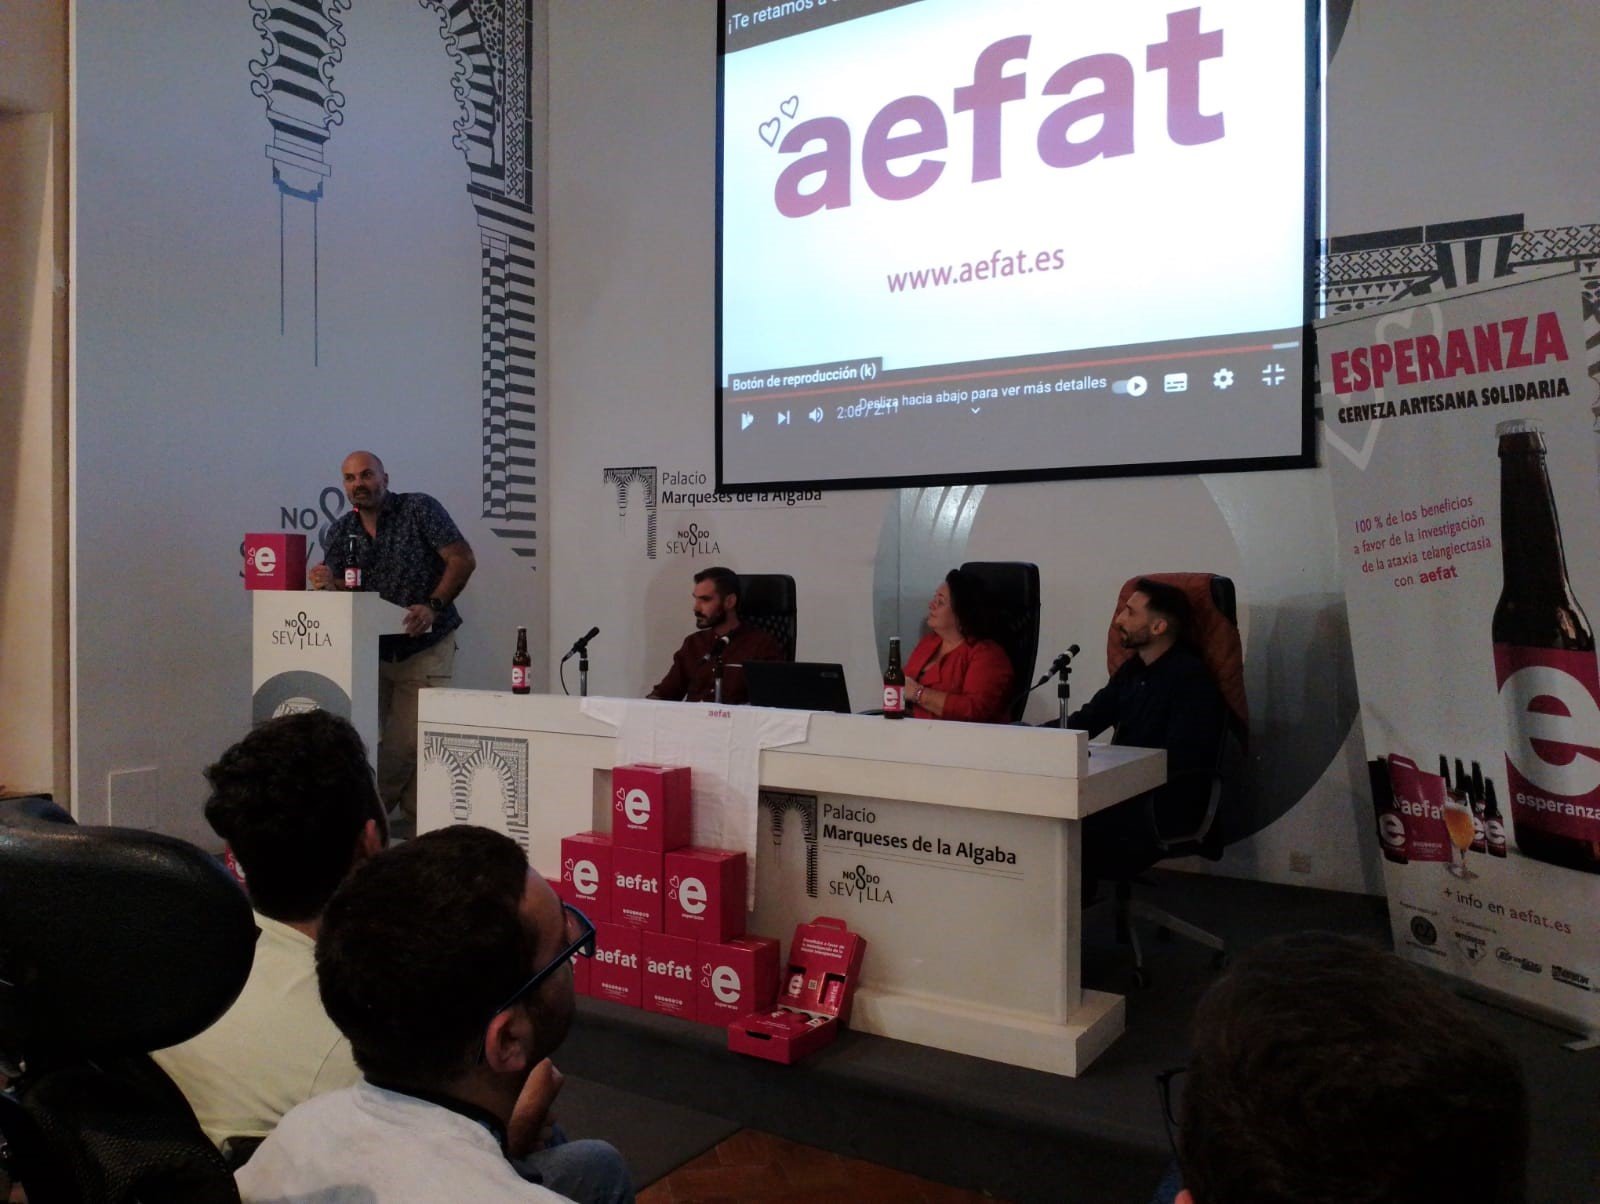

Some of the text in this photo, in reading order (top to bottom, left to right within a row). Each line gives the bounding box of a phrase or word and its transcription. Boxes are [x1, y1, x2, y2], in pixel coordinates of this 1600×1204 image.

[774, 6, 1225, 219] aefat
[886, 248, 1065, 293] www.aefat.es
[1331, 311, 1569, 395] ESPERANZA
[733, 363, 877, 391] Botón de reproducción (k)
[859, 376, 1107, 410] Desliza hacia abajo para ver más detalles
[1338, 378, 1571, 424] CERVEZA ARTESANA SOLIDARIA
[662, 471, 707, 485] Palacio
[662, 491, 733, 507] Marqueses
[772, 490, 822, 506] Algaba
[1355, 496, 1473, 534] 100 % de los beneficios
[666, 541, 720, 558] SEVILLA
[1353, 514, 1485, 554] a favor de la investigación
[255, 547, 277, 573] e
[1362, 536, 1492, 573] de la ataxia telangiectasia
[1394, 565, 1458, 588] con aefat
[272, 630, 332, 650] SEVILLA
[884, 687, 898, 706] e
[708, 710, 731, 719] aefat
[1499, 666, 1600, 797] e
[625, 788, 650, 825] e
[823, 804, 876, 824] Palacio
[1401, 800, 1444, 820] aefa
[823, 825, 1016, 865] Marqueses de la Algaba
[1379, 813, 1406, 846] e
[573, 860, 599, 894] e
[616, 874, 658, 893] aefat
[829, 880, 893, 904] SEVILLA
[678, 877, 707, 914] e
[1456, 890, 1482, 909] info
[1488, 902, 1505, 916] en
[1509, 907, 1572, 934] aefat.es
[595, 947, 638, 969] aefat
[648, 959, 692, 981] aefat
[711, 966, 741, 1003] e
